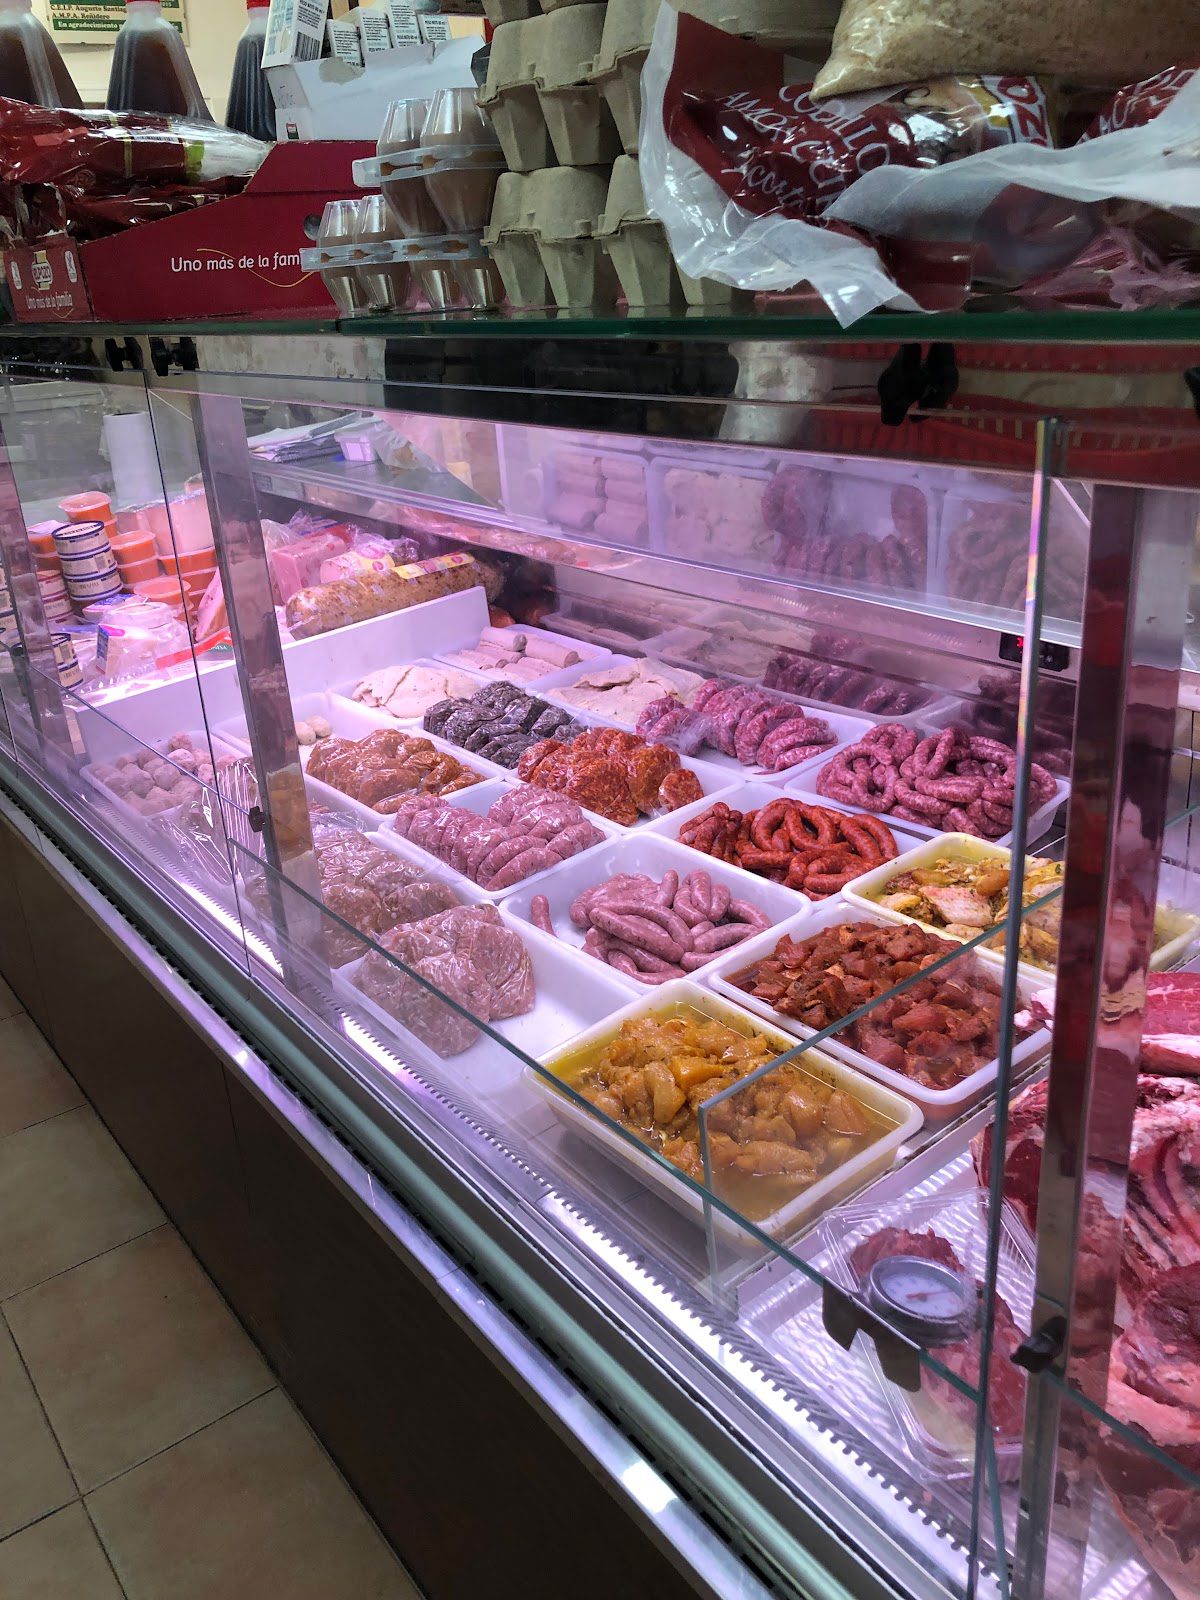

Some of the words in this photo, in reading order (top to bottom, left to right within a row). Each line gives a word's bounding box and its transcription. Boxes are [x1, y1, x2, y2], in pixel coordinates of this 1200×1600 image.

[716, 91, 807, 144] AMÓN
[779, 85, 890, 175] CODILLO
[171, 257, 202, 272] Uno
[207, 256, 234, 270] más
[238, 255, 254, 269] de
[258, 254, 270, 267] la
[273, 252, 300, 270] fam
